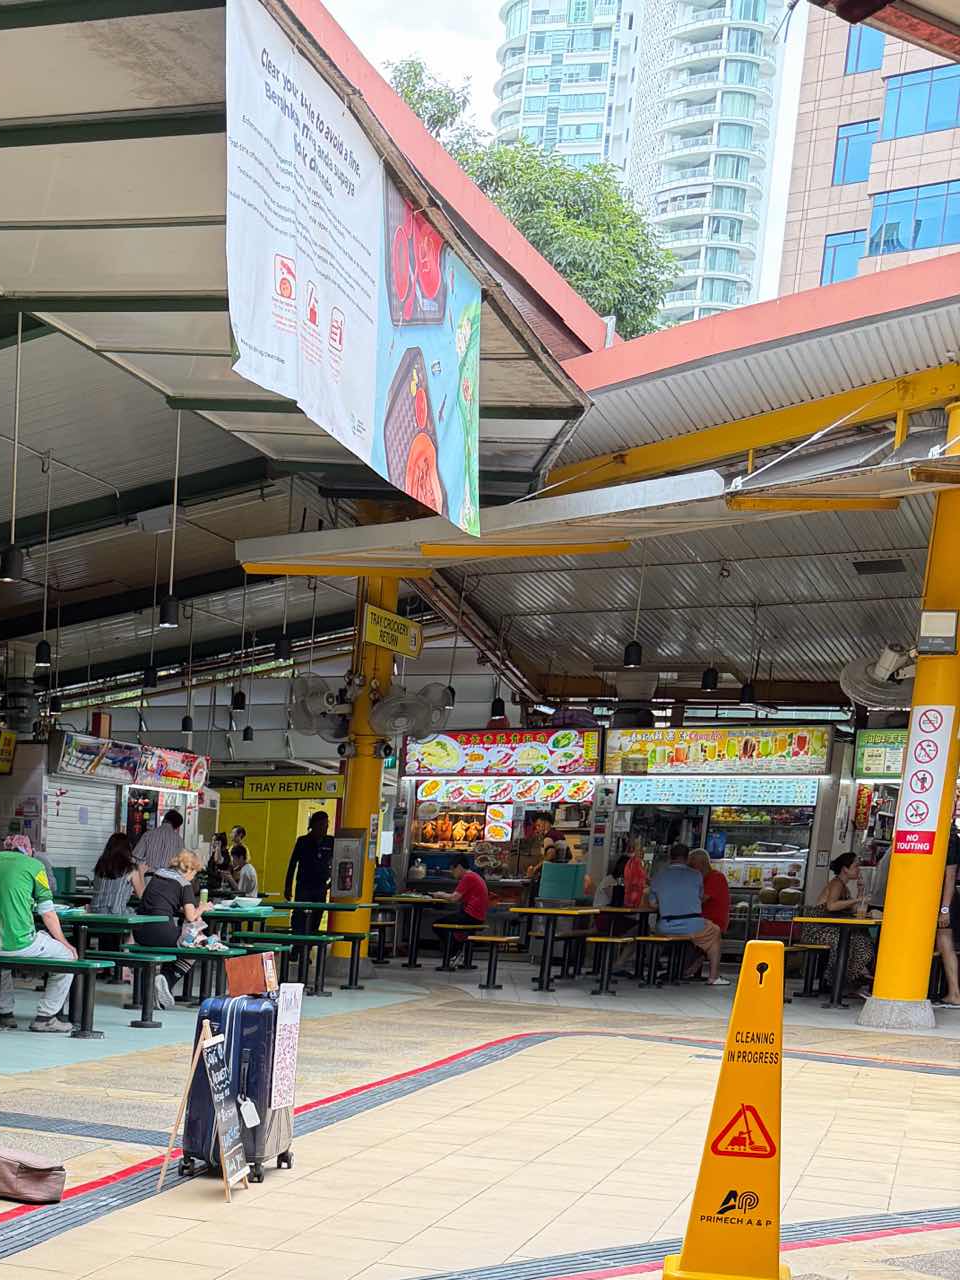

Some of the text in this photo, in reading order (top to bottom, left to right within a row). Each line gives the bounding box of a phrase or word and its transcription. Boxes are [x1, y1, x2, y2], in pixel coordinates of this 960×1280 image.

[261, 47, 281, 82] Clear
[282, 72, 299, 100] your
[315, 113, 326, 133] to
[324, 125, 345, 153] avoid
[348, 148, 361, 178] fine.
[378, 630, 400, 647] RETURN
[248, 782, 322, 793] TRAY RETURN
[906, 833, 919, 842] NO
[896, 842, 930, 850] TOUTING
[735, 1031, 775, 1045] CLEANING
[727, 1050, 779, 1065] IN PROGRESS
[700, 1215, 772, 1228] PRIMECH A & P
